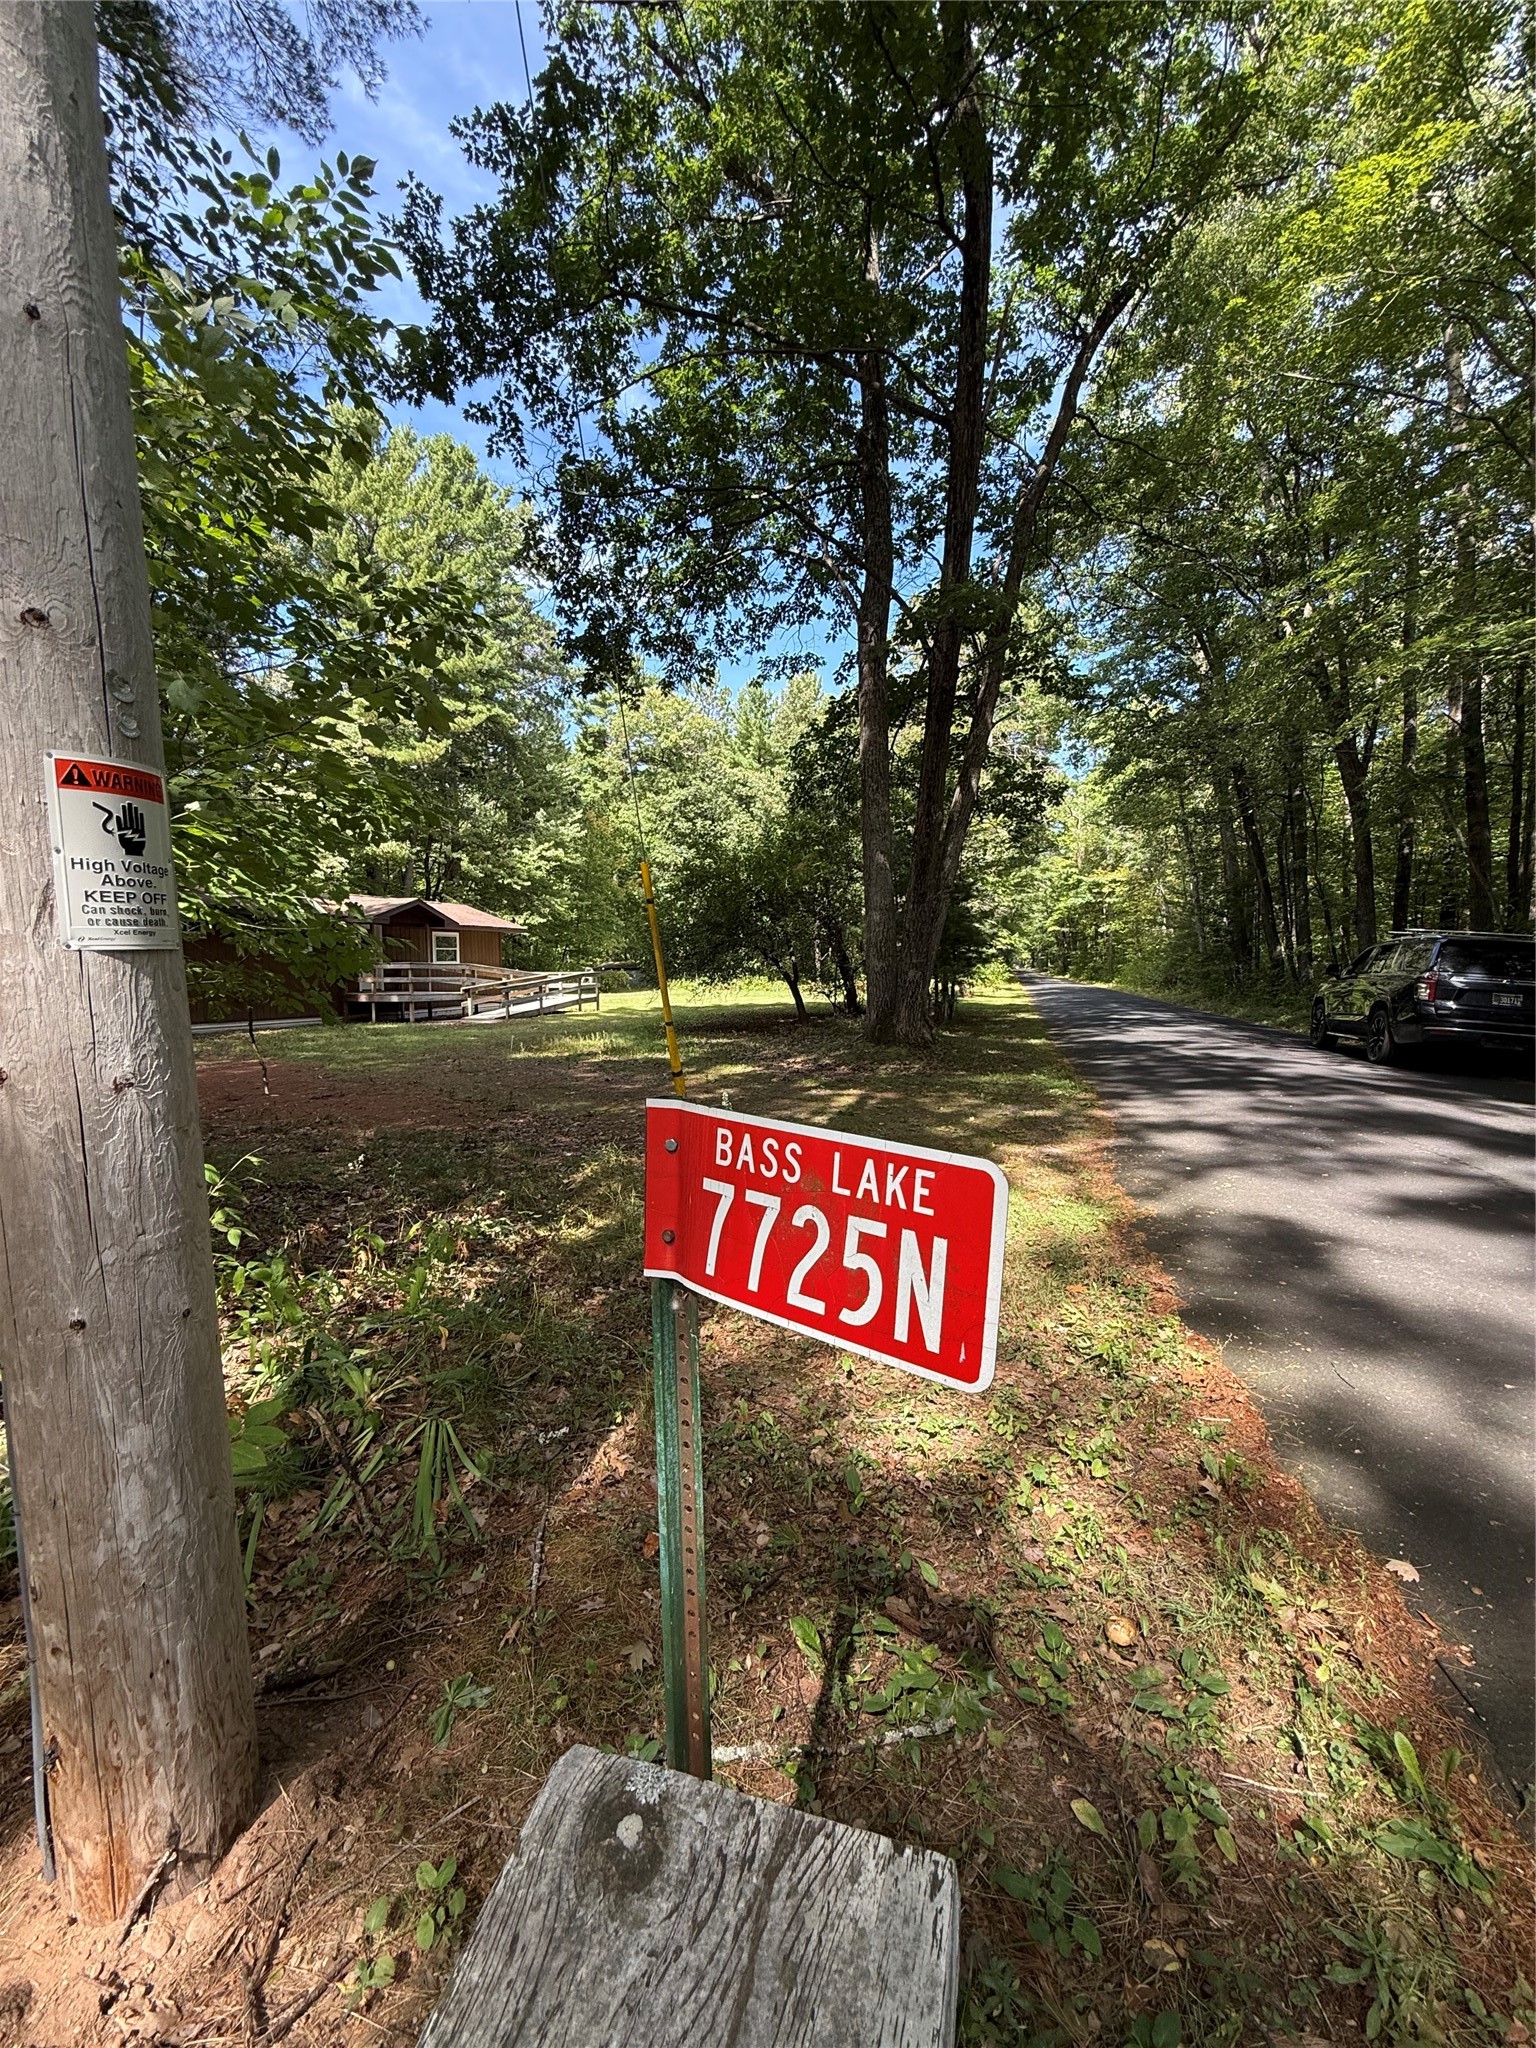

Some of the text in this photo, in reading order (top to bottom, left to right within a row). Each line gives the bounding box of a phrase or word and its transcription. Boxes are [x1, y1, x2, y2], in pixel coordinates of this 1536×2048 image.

[92, 769, 163, 798] WARNING
[71, 858, 169, 878] High Voltage
[101, 874, 157, 888] Above.
[84, 890, 167, 905] KEEP OFF
[82, 905, 106, 915] Can
[110, 906, 146, 917] shock,
[87, 918, 101, 926] or
[105, 918, 139, 927] cause
[715, 1127, 936, 1216] BASS LAKE
[702, 1177, 948, 1354] 7725N
